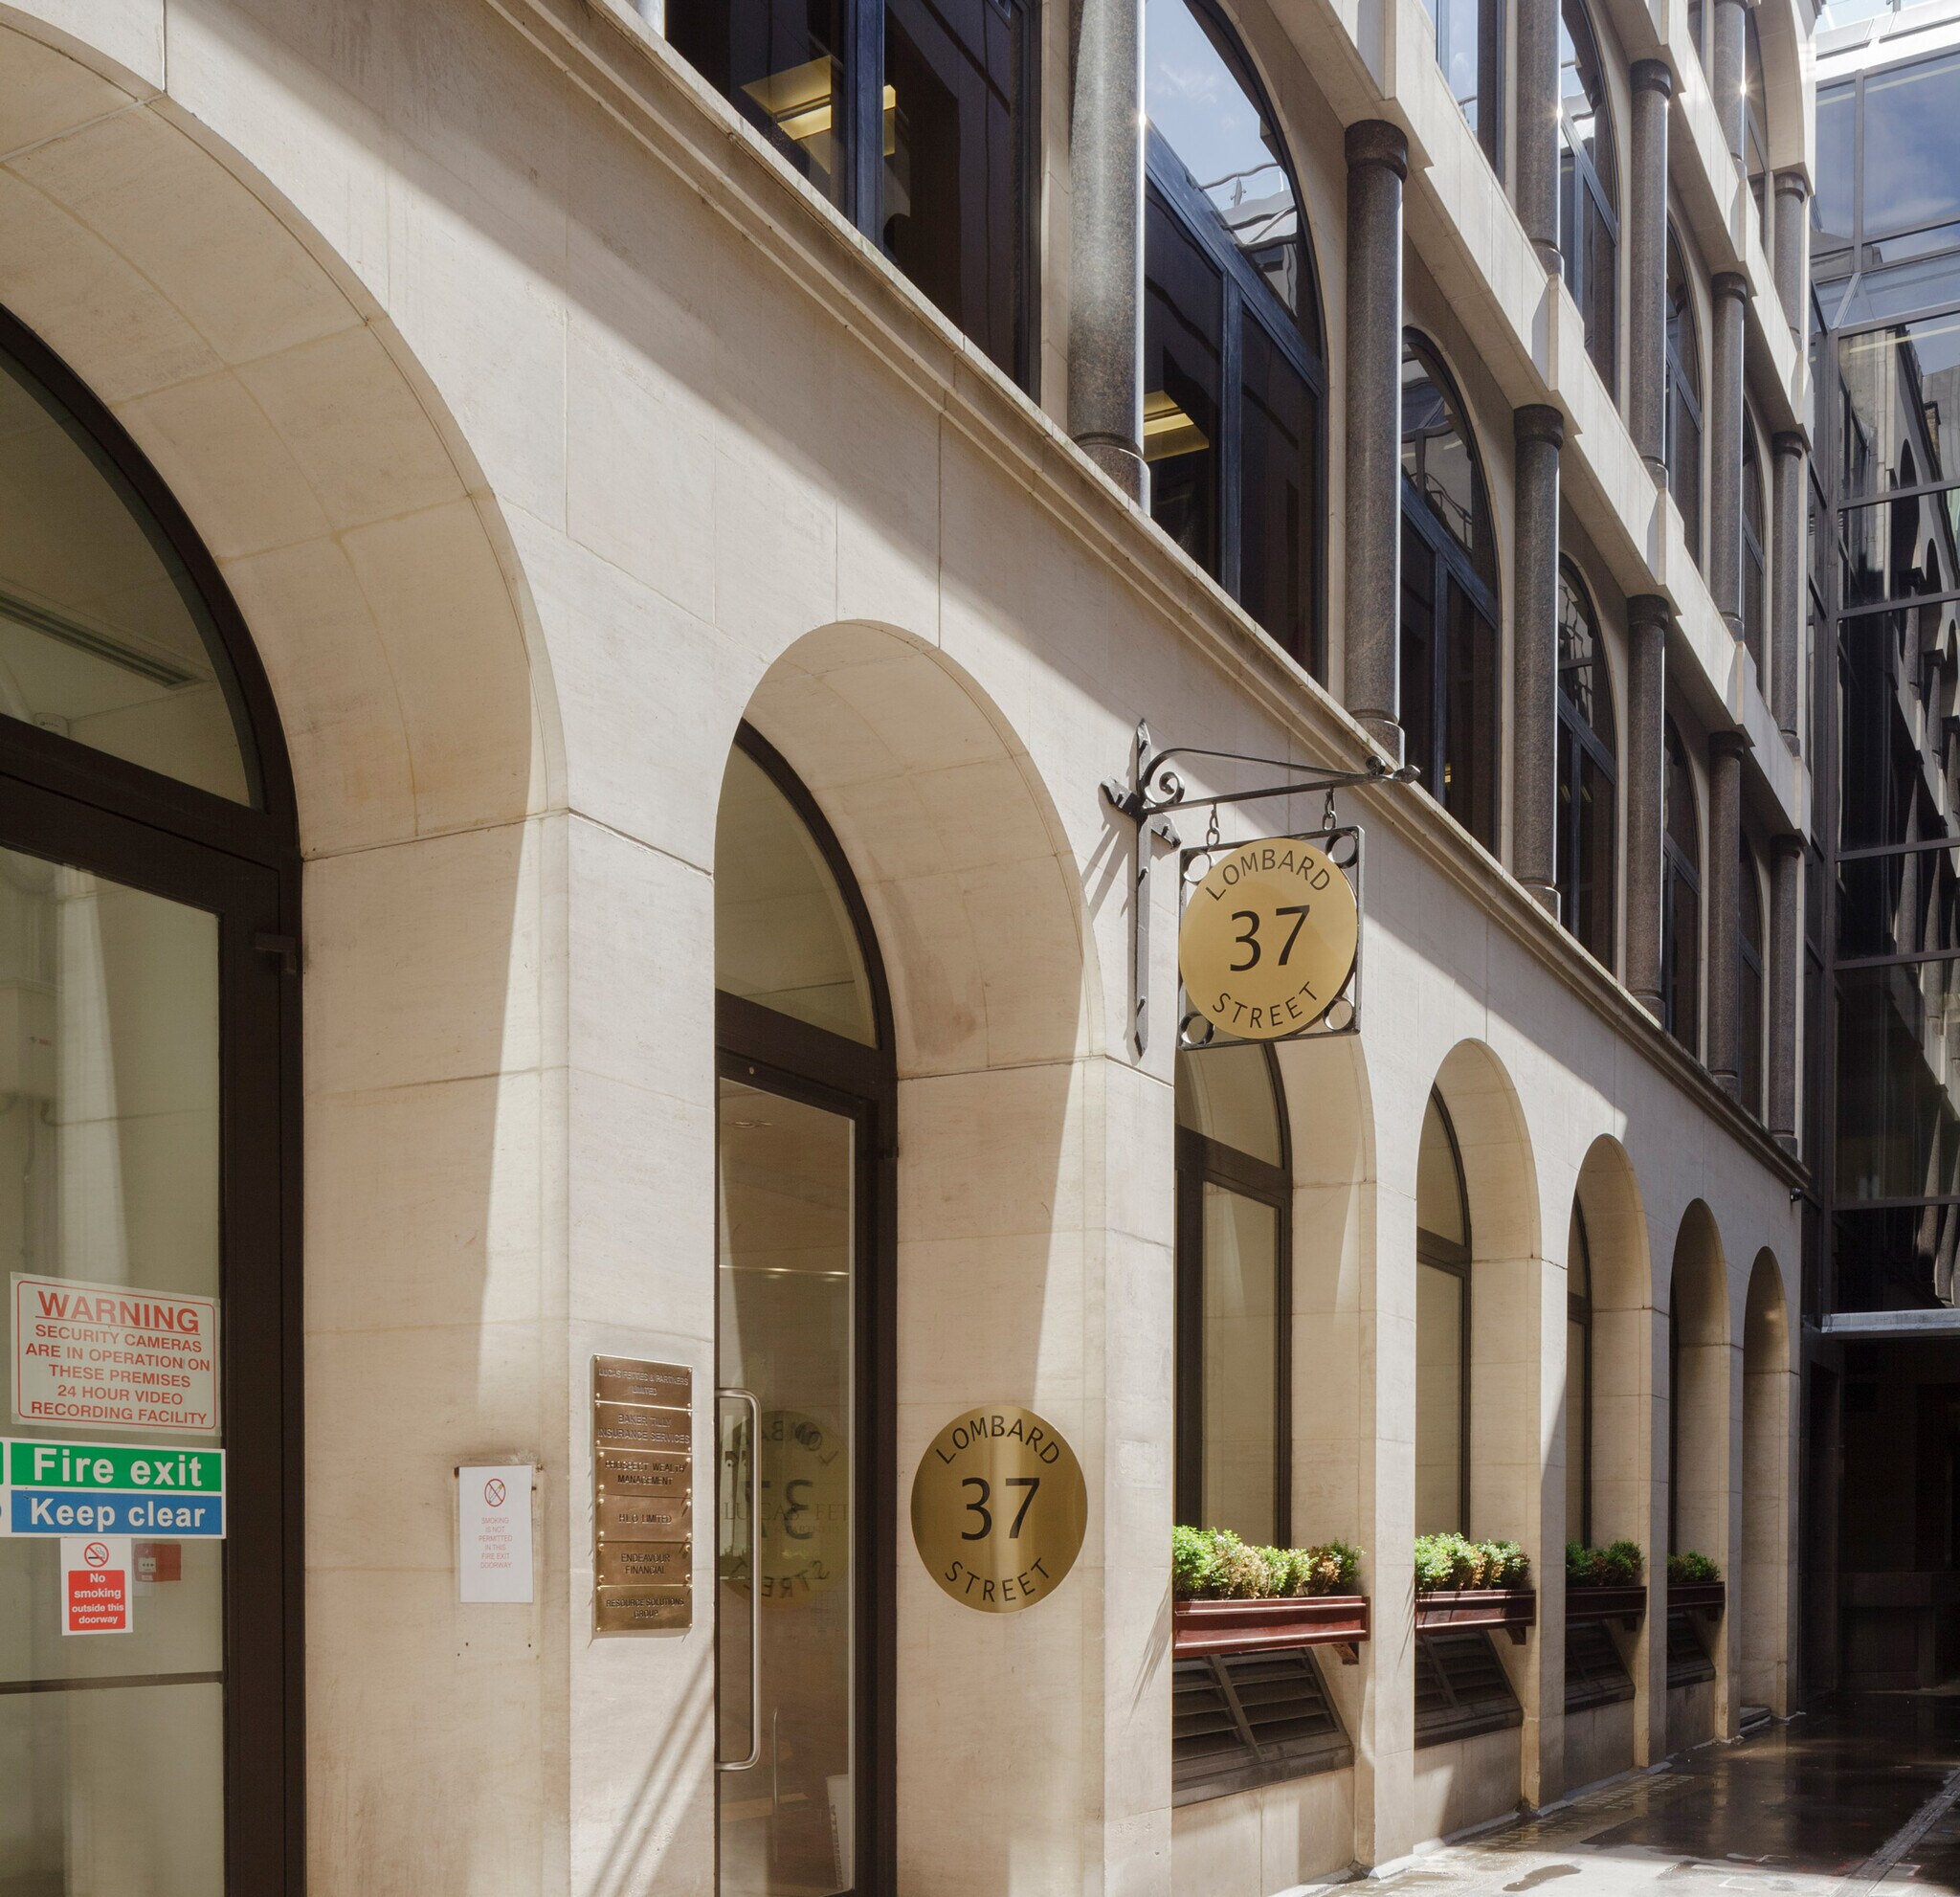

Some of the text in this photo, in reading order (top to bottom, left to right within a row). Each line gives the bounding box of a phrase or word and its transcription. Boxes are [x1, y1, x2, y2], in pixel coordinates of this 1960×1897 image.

[1205, 848, 1330, 902] LOMBARD
[1230, 904, 1310, 971] 37
[1212, 981, 1318, 1029] STREET
[37, 1290, 199, 1332] WARNING
[34, 1324, 202, 1353] SECURITY CAMERAS
[25, 1343, 211, 1372] ARE IN OPERATION ON
[48, 1364, 190, 1388] THESE PREMISES
[598, 1368, 622, 1378] LUCAS
[655, 1373, 689, 1386] PARTNERS
[57, 1384, 183, 1405] 24 HOUR VIDEO
[31, 1401, 207, 1424] RECORDING FACILITY
[617, 1414, 648, 1426] BAKER
[597, 1427, 690, 1444] INSURANCE SERVICES
[936, 1415, 1059, 1464] LOMBARD
[33, 1447, 202, 1486] Fire exit
[605, 1460, 686, 1474] PROSPECT WEALTH
[617, 1474, 674, 1485] MANAGEMENT
[31, 1497, 206, 1532] Keep clear
[961, 1477, 1040, 1541] 37
[642, 1514, 672, 1524] LIMITED
[621, 1552, 671, 1563] ENDEAVOUR
[90, 1573, 105, 1583] No
[625, 1565, 666, 1575] FINANCIAL
[945, 1557, 1050, 1602] STREET
[74, 1588, 122, 1599] smoking
[606, 1597, 685, 1608] RESOURCE SOLUTIONS
[72, 1602, 124, 1613] outside this
[634, 1609, 658, 1618] GROUP
[78, 1616, 118, 1624] doorway
